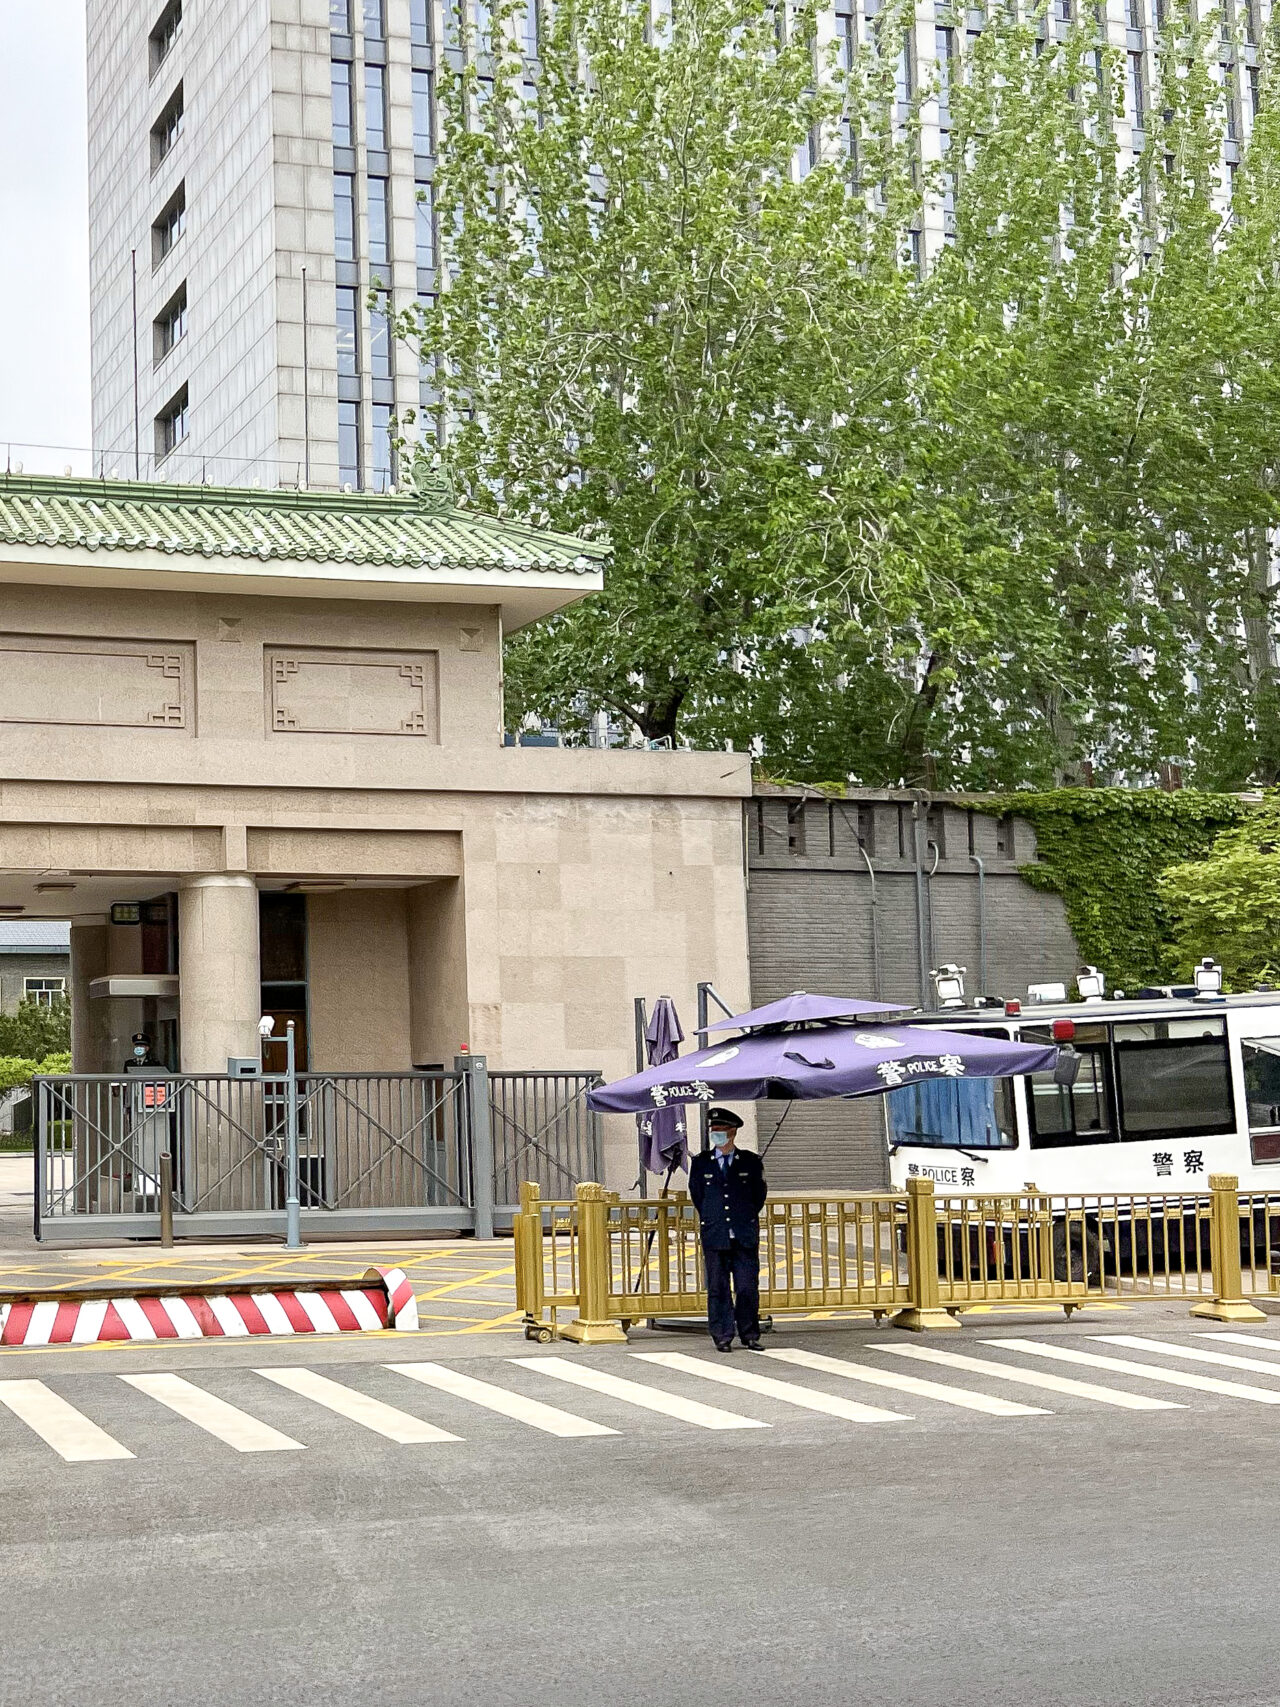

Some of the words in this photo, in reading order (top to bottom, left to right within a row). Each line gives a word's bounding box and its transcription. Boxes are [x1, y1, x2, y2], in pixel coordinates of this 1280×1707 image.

[877, 1060, 906, 1085] 警
[907, 1061, 938, 1074] POLICE
[939, 1054, 965, 1077] 察
[650, 1084, 669, 1107] 警
[668, 1085, 694, 1097] POLICE
[690, 1079, 715, 1101] 察
[1152, 1150, 1204, 1176] 警察
[922, 1168, 958, 1183] POLICE
[960, 1167, 976, 1187] 察
